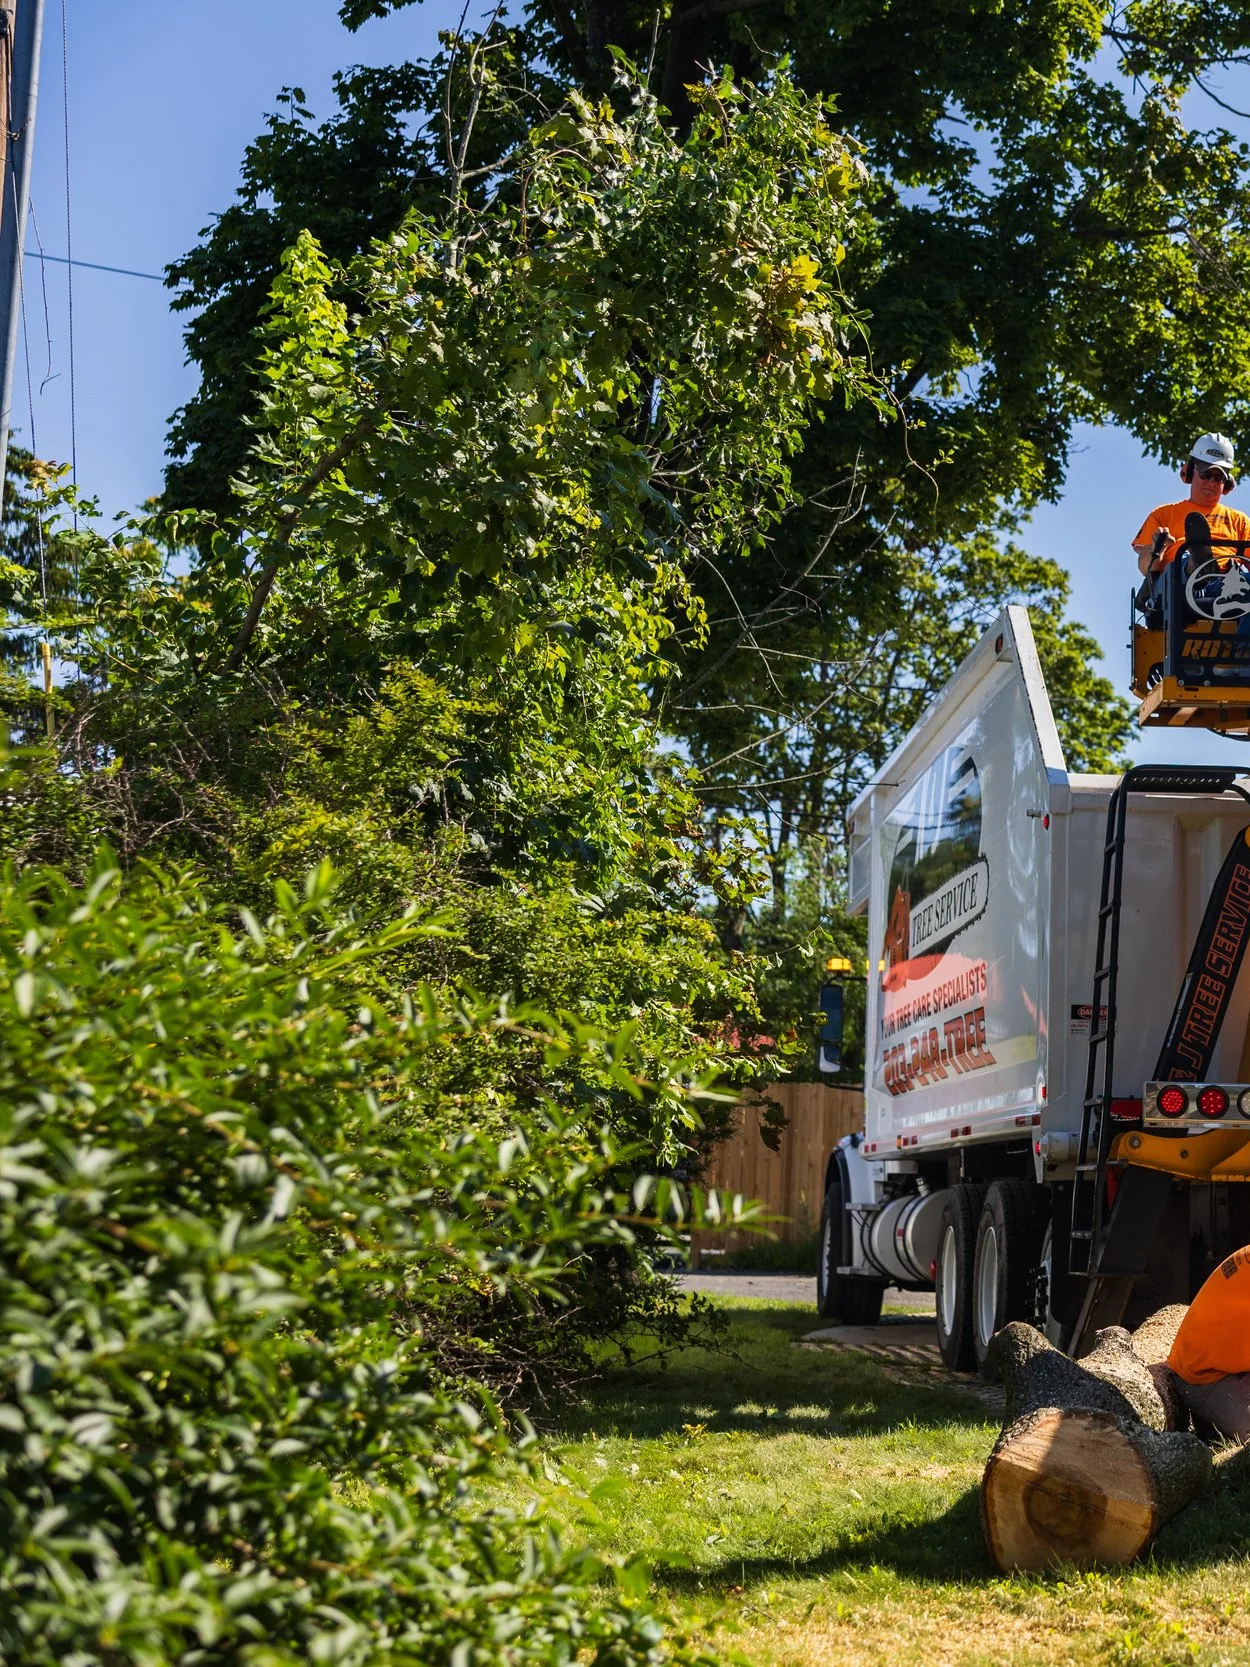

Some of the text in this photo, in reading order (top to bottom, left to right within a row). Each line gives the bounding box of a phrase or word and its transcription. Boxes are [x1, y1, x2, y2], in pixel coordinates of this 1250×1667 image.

[911, 871, 979, 948] TREE SERVICE
[896, 1001, 912, 1032] TREE
[912, 992, 932, 1024] CARE
[932, 962, 987, 1014] SPECIALISTS
[1182, 973, 1226, 1047] TREE
